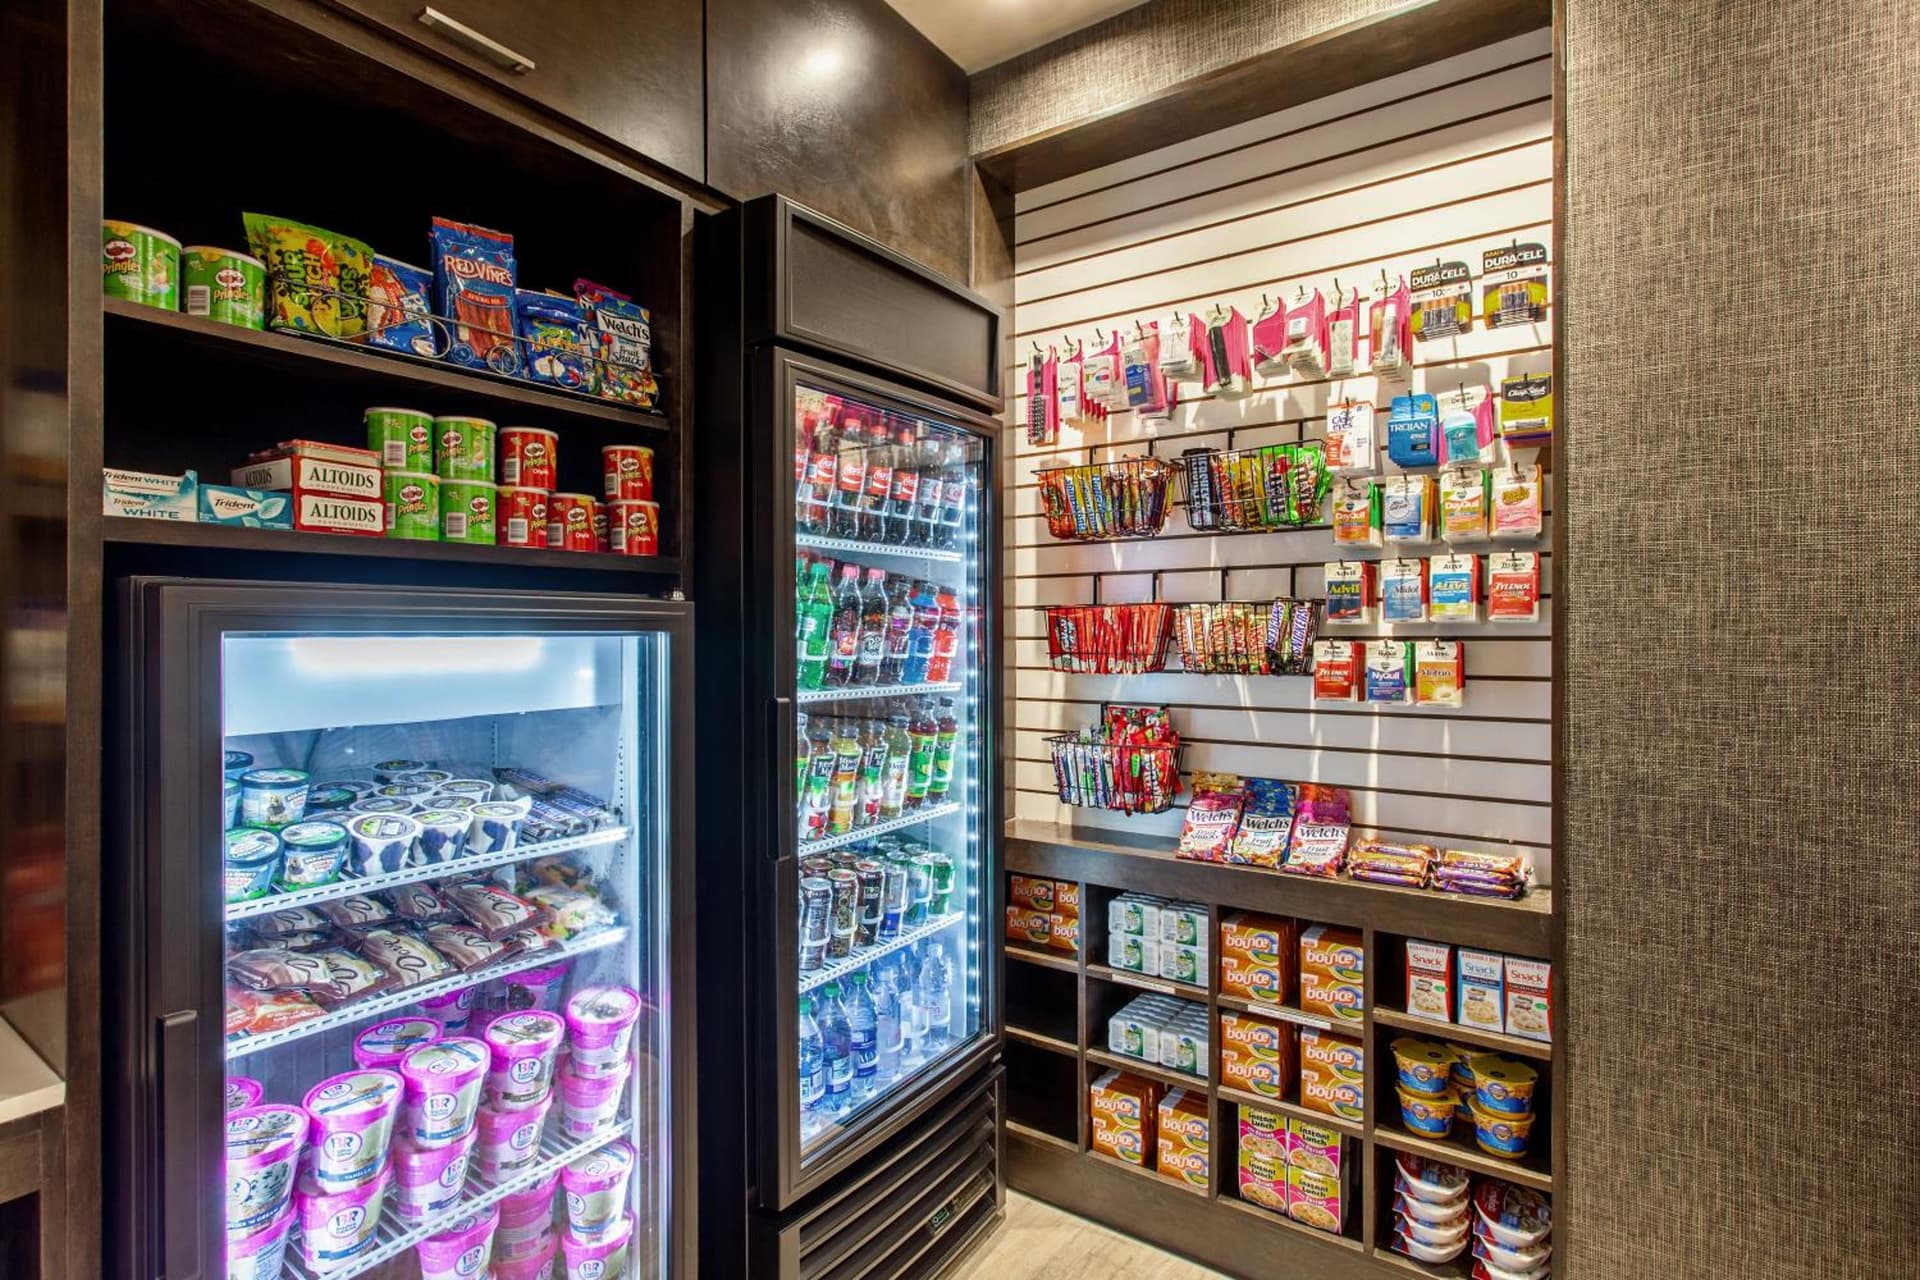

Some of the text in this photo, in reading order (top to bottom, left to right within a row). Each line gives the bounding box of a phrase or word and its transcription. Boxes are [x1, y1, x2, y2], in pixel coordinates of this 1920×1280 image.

[1485, 249, 1544, 268] DURACELL
[444, 255, 514, 286] RED VINES
[1412, 266, 1467, 286] DURACELL
[1506, 270, 1519, 280] 10
[1432, 287, 1444, 298] 10
[601, 315, 650, 341] Welch's
[1389, 421, 1429, 433] TROJAN
[104, 471, 142, 483] Trident
[308, 466, 375, 489] ALTOIDS
[113, 498, 145, 506] Trident
[215, 498, 256, 510] Trident
[122, 507, 180, 519] WHITE
[310, 502, 377, 523] ALTOIDS
[1329, 583, 1361, 594] Advil
[1291, 607, 1311, 657] SNICKERS
[1371, 671, 1400, 681] NyQuil
[1190, 810, 1233, 822] Welch's
[1245, 817, 1291, 830] Welch's
[1300, 826, 1347, 838] Welch's
[1015, 885, 1048, 899] bounce
[1009, 917, 1043, 932] bounce
[1226, 933, 1270, 950] bounce
[1306, 949, 1356, 966] bounce
[1412, 954, 1443, 967] Snack
[1465, 961, 1497, 976] Snack
[1226, 968, 1271, 985] bounce
[1510, 969, 1545, 983] Snack
[1306, 987, 1356, 1004] bounce
[1226, 1025, 1271, 1043] bounce
[1306, 1047, 1356, 1065] bounce
[1227, 1062, 1272, 1080] bounce
[1306, 1083, 1356, 1101] bounce
[1094, 1095, 1134, 1113] bounce
[1248, 1110, 1277, 1123] Instant
[1162, 1117, 1203, 1137] bounce
[1251, 1118, 1275, 1130] Lunch
[1096, 1130, 1135, 1147] bounce
[1299, 1126, 1330, 1140] Instant
[1302, 1134, 1328, 1146] Lunch
[1162, 1151, 1203, 1171] bounce
[1248, 1160, 1276, 1174] Instant
[1251, 1169, 1274, 1180] Lunch
[1299, 1178, 1329, 1192] Instant
[1302, 1186, 1327, 1198] Lunch
